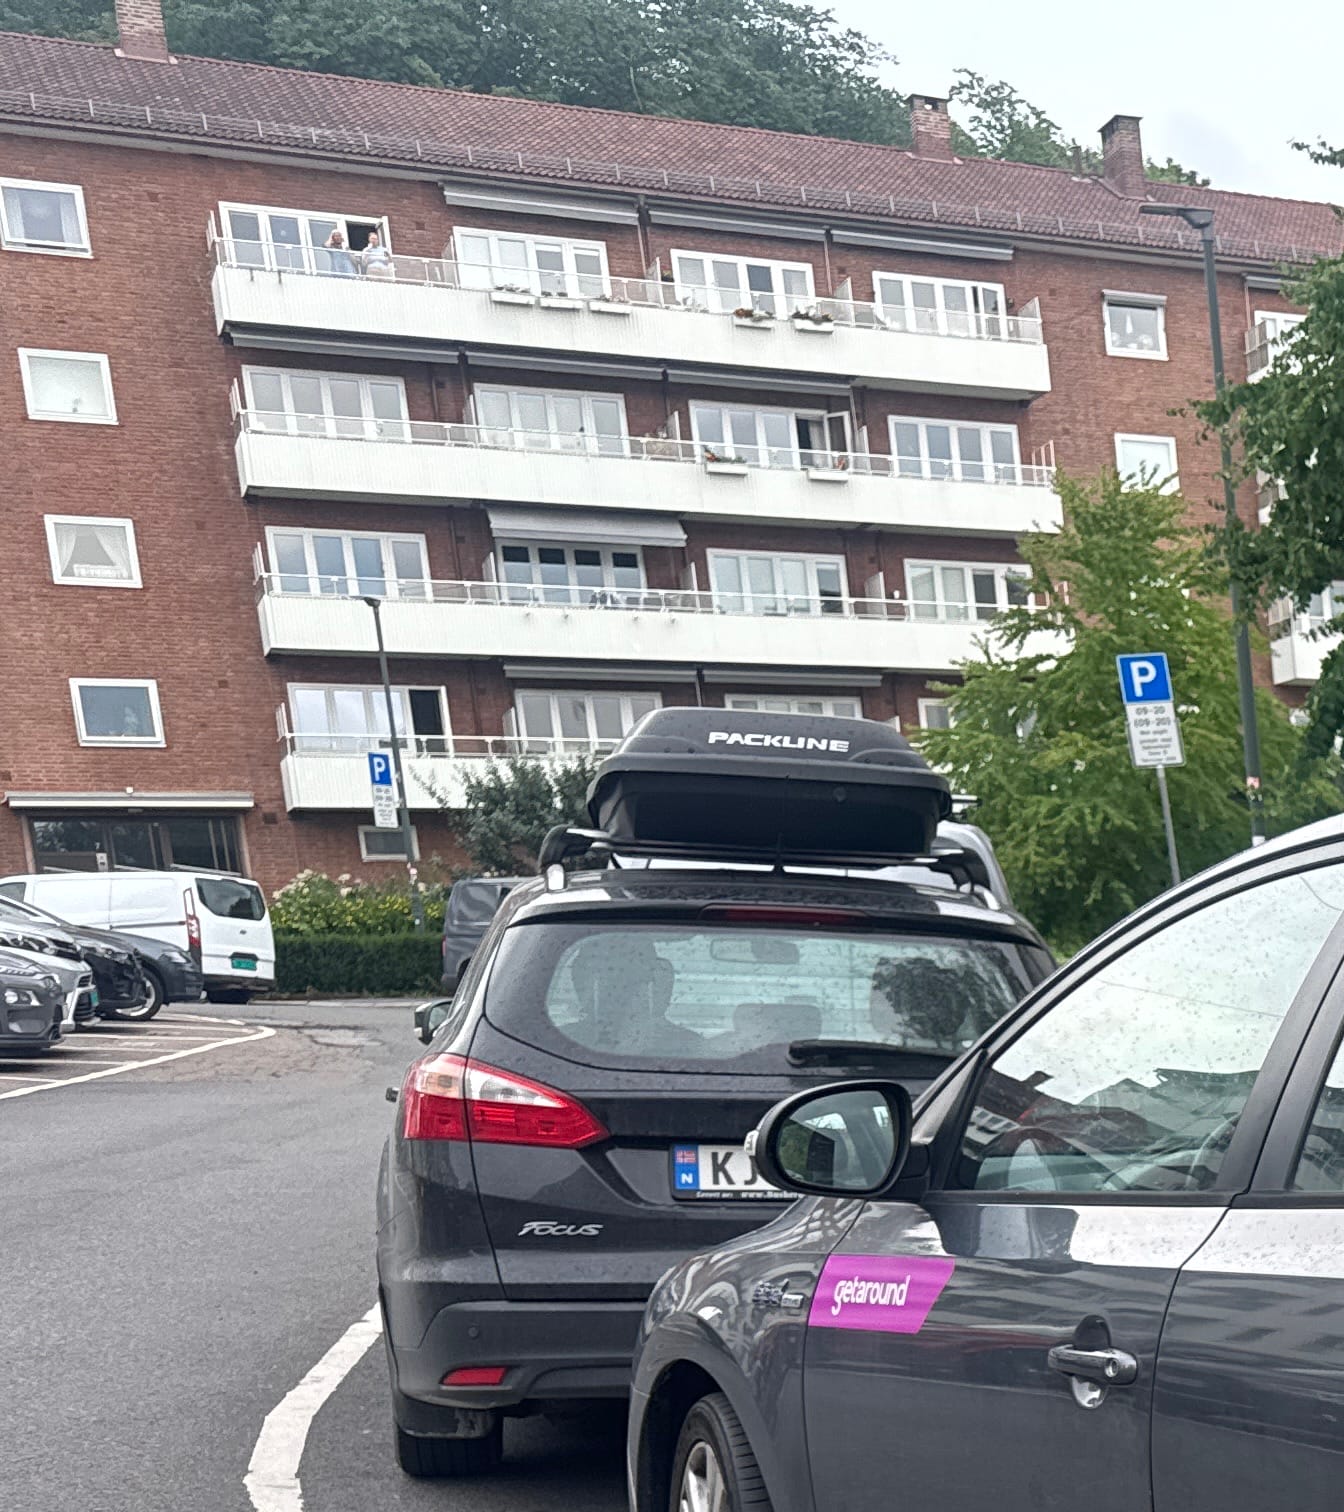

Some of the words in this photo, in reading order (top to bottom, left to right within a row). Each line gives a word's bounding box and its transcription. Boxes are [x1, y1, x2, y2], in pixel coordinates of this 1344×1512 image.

[1129, 660, 1157, 698] P
[708, 731, 850, 753] PACKLINE
[373, 756, 386, 782] P
[680, 1173, 693, 1184] N
[831, 1274, 911, 1316] getaround
